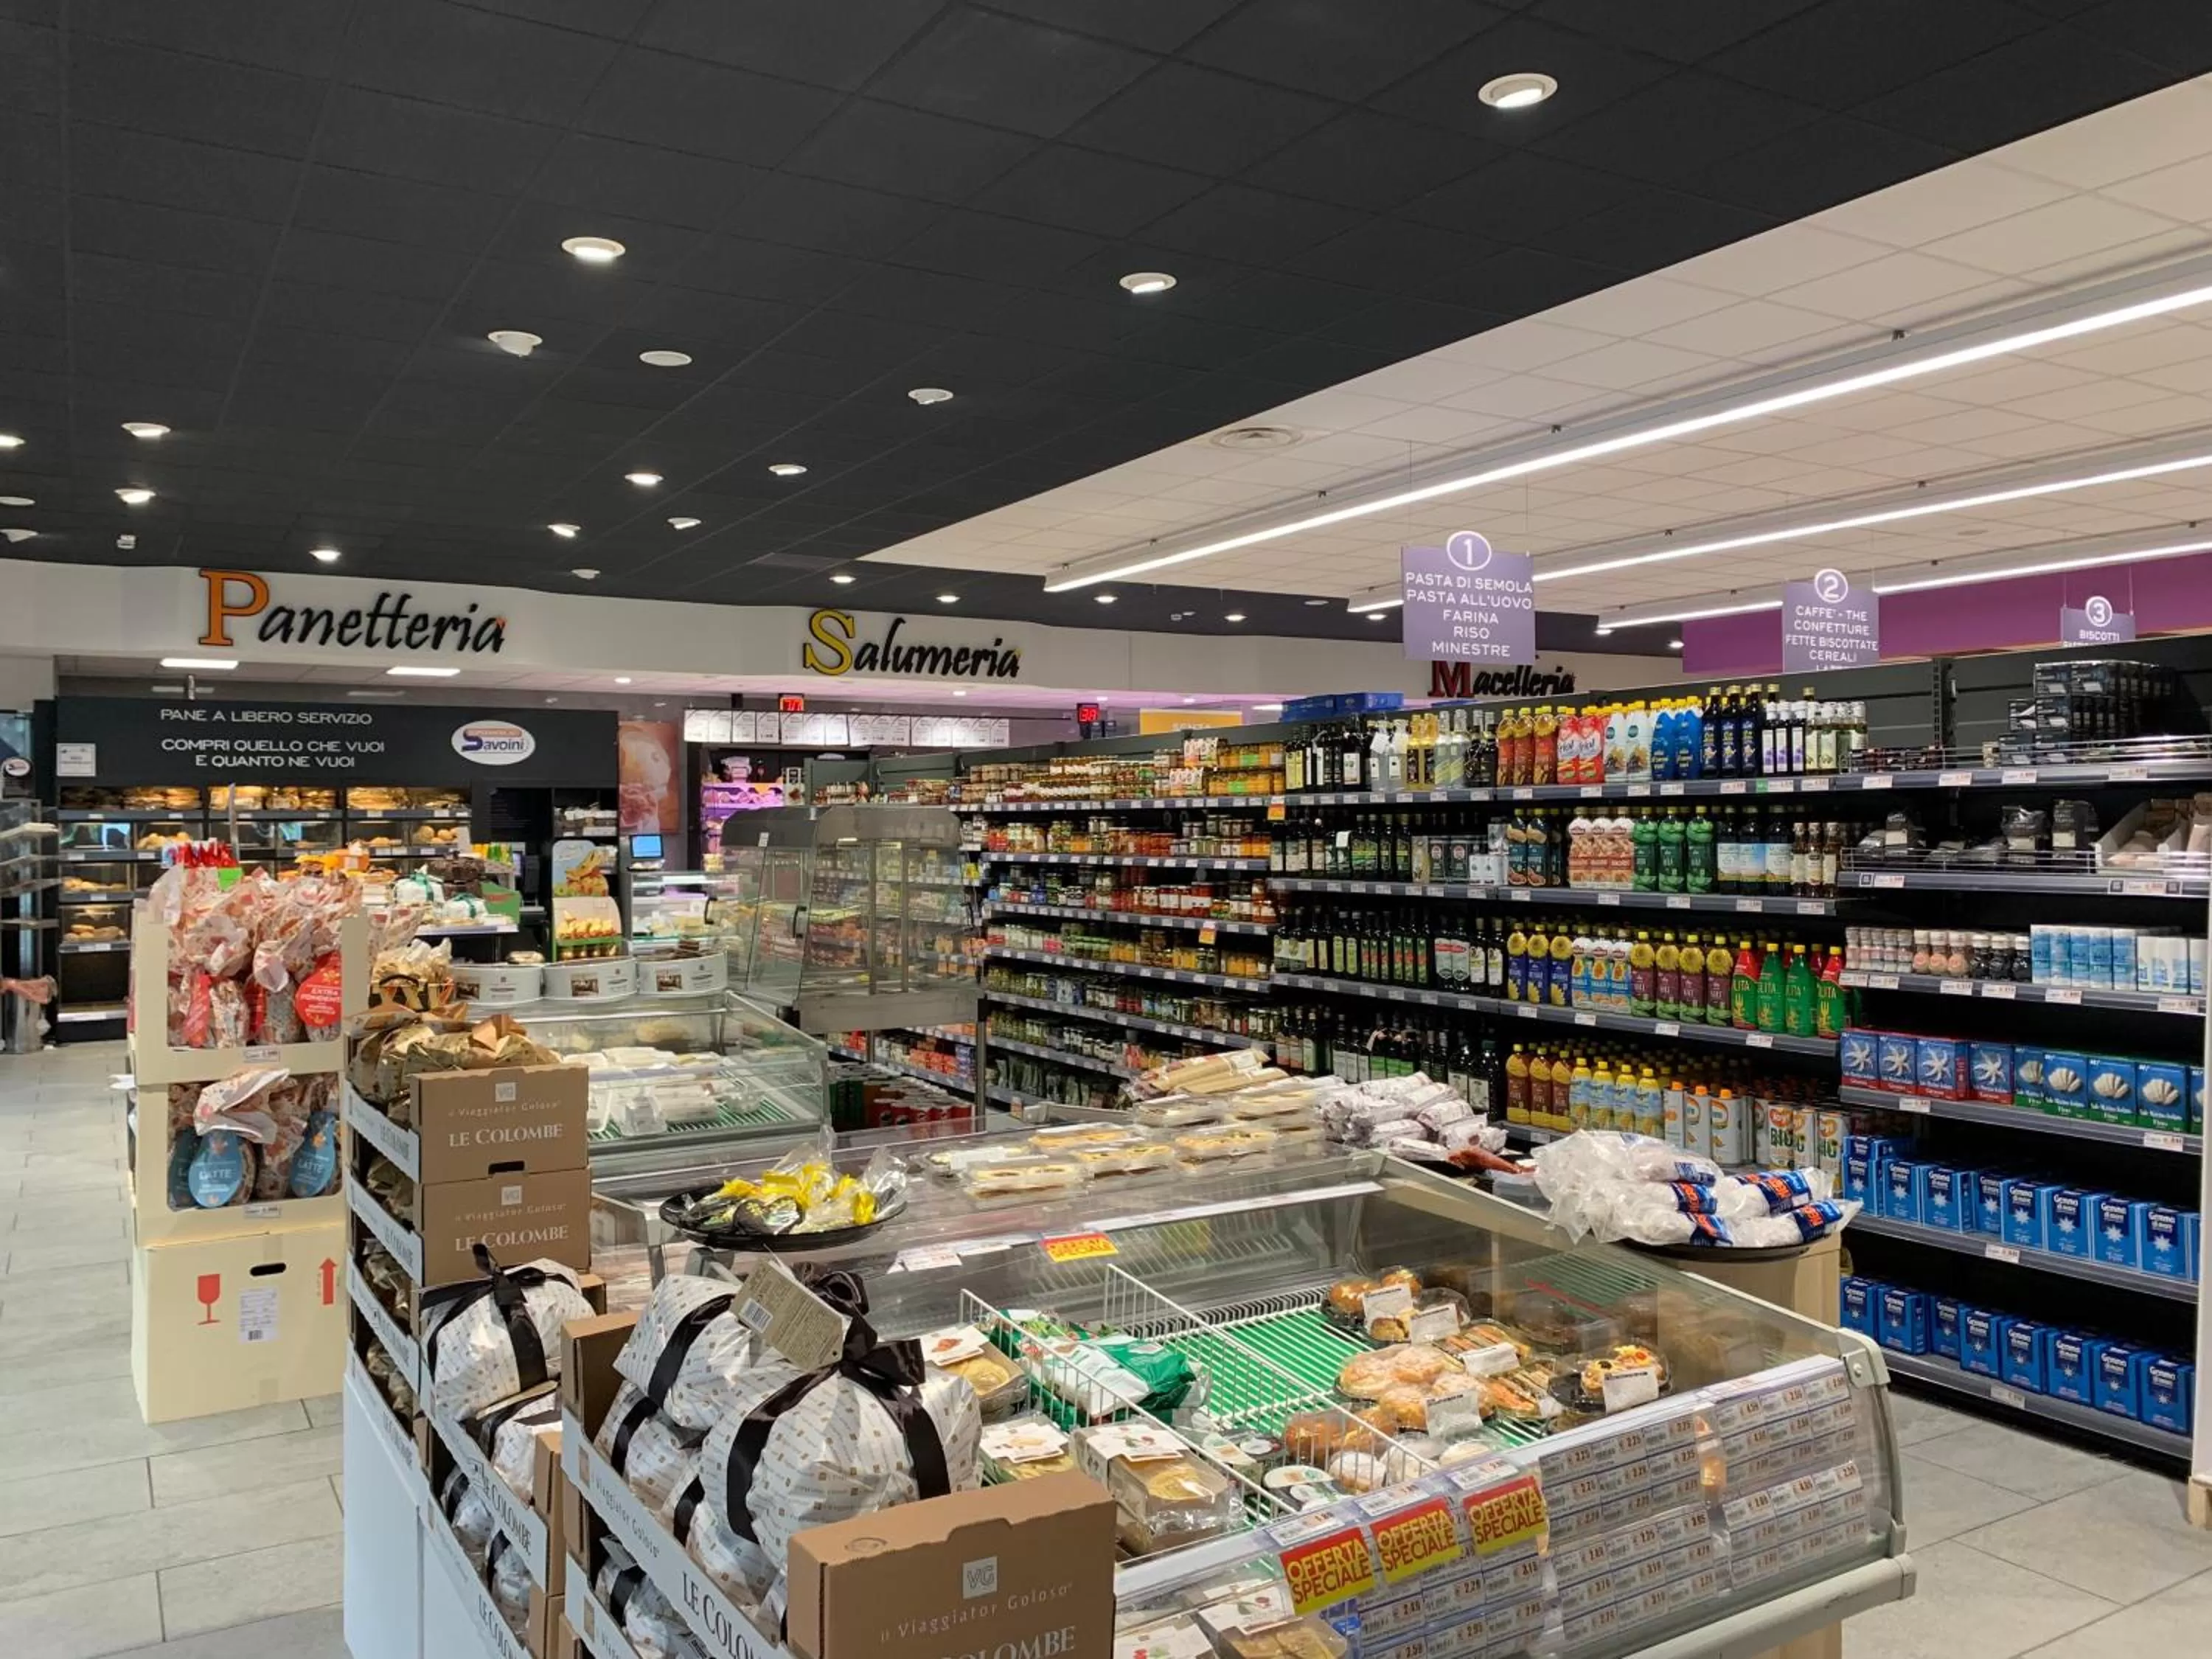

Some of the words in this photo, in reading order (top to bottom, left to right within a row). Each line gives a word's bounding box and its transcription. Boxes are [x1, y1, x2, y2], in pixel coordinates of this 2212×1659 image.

[1463, 538, 1473, 565] 1
[1405, 572, 1453, 588] PASTA
[1456, 577, 1471, 588] DI
[1475, 578, 1533, 593] SEMOLA
[1823, 575, 1840, 599] 2
[198, 568, 507, 653] Panetteria
[1407, 590, 1455, 604] PASTA
[1461, 593, 1532, 610] ALL'UOVO
[1443, 610, 1499, 624] FARINA
[1846, 611, 1868, 622] THE
[2093, 602, 2106, 623] 3
[1453, 626, 1489, 639] RISO
[1794, 619, 1871, 636] CONFETTURE
[803, 608, 1022, 678] Salumeria
[1432, 641, 1511, 657] MINESTRE
[1785, 634, 1817, 647] FETTE
[1819, 637, 1878, 651] BISCOTTATE
[1809, 650, 1857, 662] CEREALI
[1427, 661, 1576, 698] Macelleria
[160, 709, 207, 721] PANE
[212, 710, 226, 721] A
[231, 711, 293, 723] LIBERO
[297, 712, 372, 725] SERVIZIO
[161, 738, 230, 751] COMPRI
[234, 740, 302, 752] QUELLO
[307, 741, 341, 752] CHE
[345, 741, 385, 753] VUOI
[195, 755, 207, 766] E
[212, 755, 285, 768] QUANTO
[288, 756, 310, 768] NE
[316, 756, 355, 768] VUOI
[1733, 981, 1750, 992] LITA
[448, 1132, 470, 1148] LE
[475, 1123, 563, 1145] COLOMBE
[198, 1167, 233, 1179] LATTE
[297, 1161, 324, 1173] LATTE
[455, 1236, 476, 1251] LE
[480, 1224, 569, 1248] COLOMBE
[1469, 1484, 1544, 1526] OFFERTA
[1377, 1509, 1454, 1549] OFFERTA
[1475, 1505, 1545, 1545] SPECIALE
[1287, 1537, 1368, 1580] OFFERTA
[1381, 1531, 1458, 1573] SPECIALE
[1292, 1559, 1372, 1605] SPECIALE
[683, 1571, 700, 1615] LE
[703, 1593, 756, 1659] COLO
[897, 1603, 998, 1639] Viaggiator
